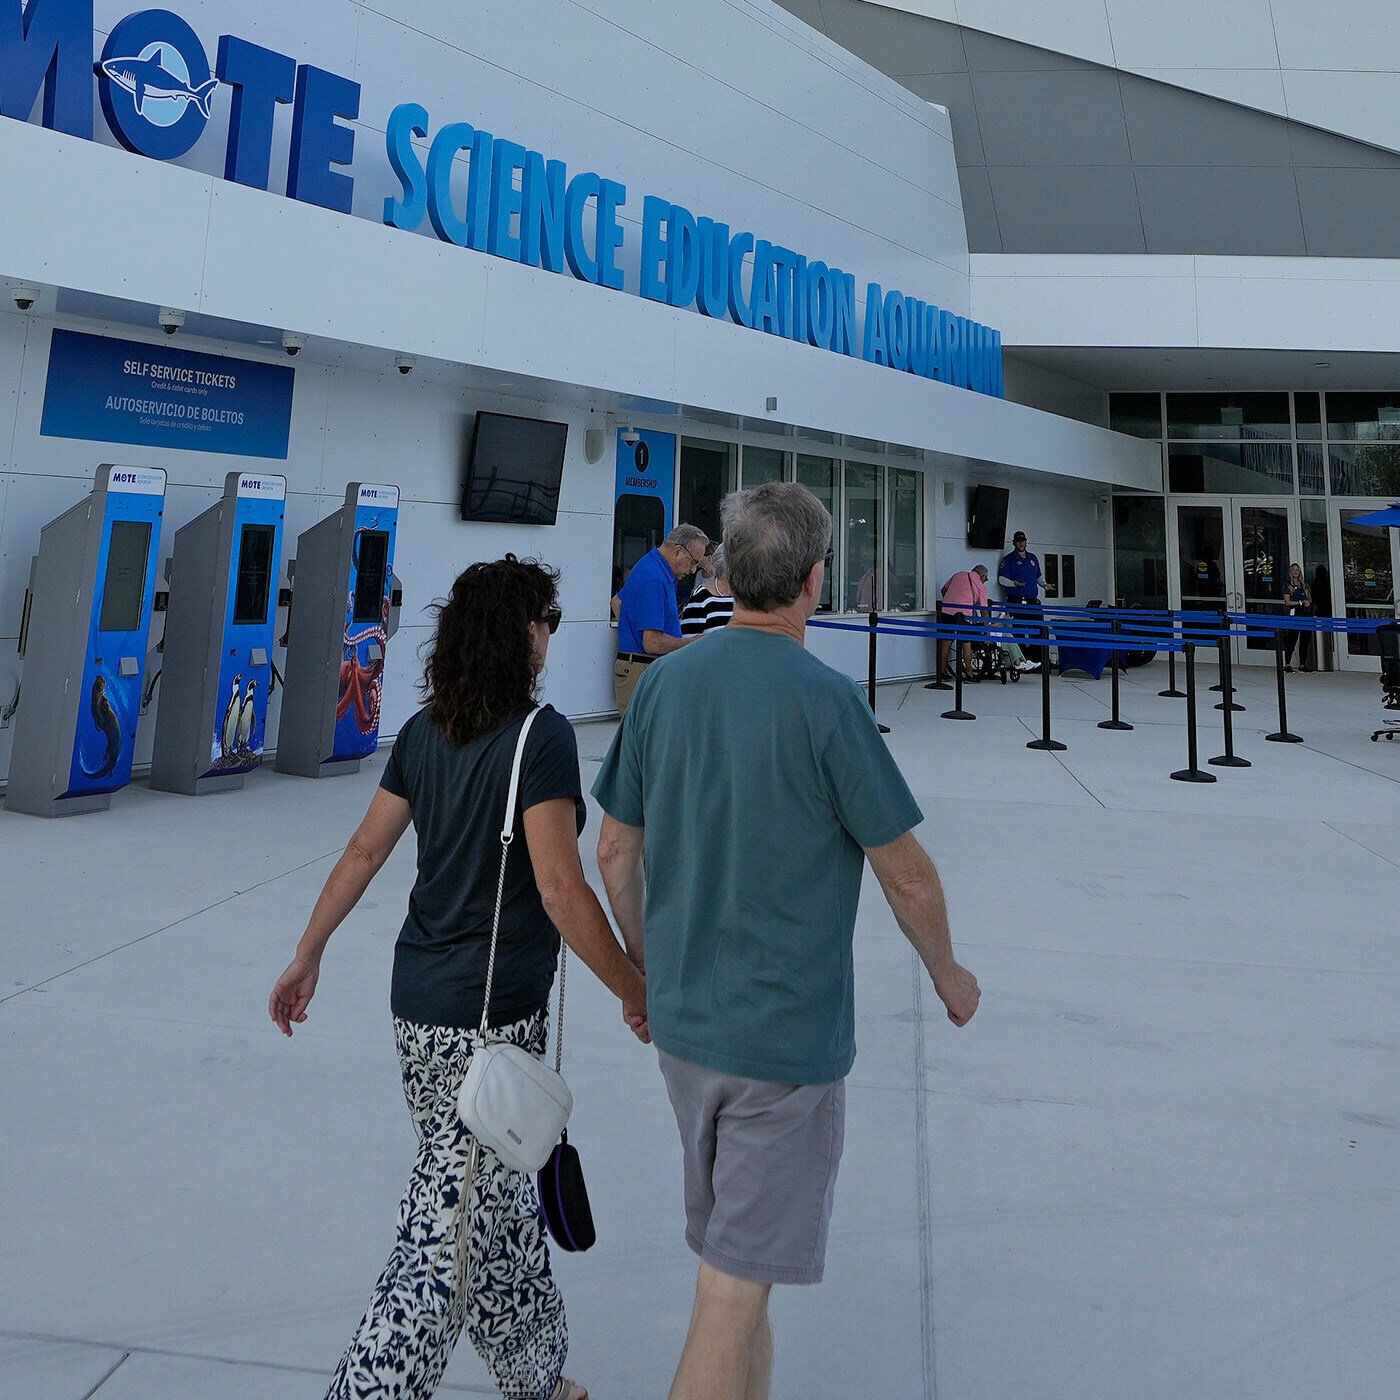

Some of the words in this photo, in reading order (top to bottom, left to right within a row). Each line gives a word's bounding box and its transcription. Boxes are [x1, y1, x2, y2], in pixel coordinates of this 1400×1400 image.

[383, 102, 626, 291] SCIENCE
[639, 194, 856, 357] EDUCATION
[863, 282, 1003, 399] AQUARIUM
[123, 360, 149, 376] SELF
[150, 364, 193, 383] SERVICE
[195, 371, 236, 389] TICKETS
[151, 381, 167, 390] Credit
[167, 383, 171, 391] &
[198, 388, 208, 396] only
[105, 395, 184, 418] AUTOSERVICIO
[186, 406, 199, 420] DE
[201, 408, 244, 425] BOLETOS
[139, 416, 150, 425] Solo
[640, 449, 644, 465] 1
[112, 472, 137, 483] MOTE
[625, 477, 658, 488] MEMBERSHIP
[241, 479, 261, 490] MOTE
[360, 489, 378, 499] MOTE
